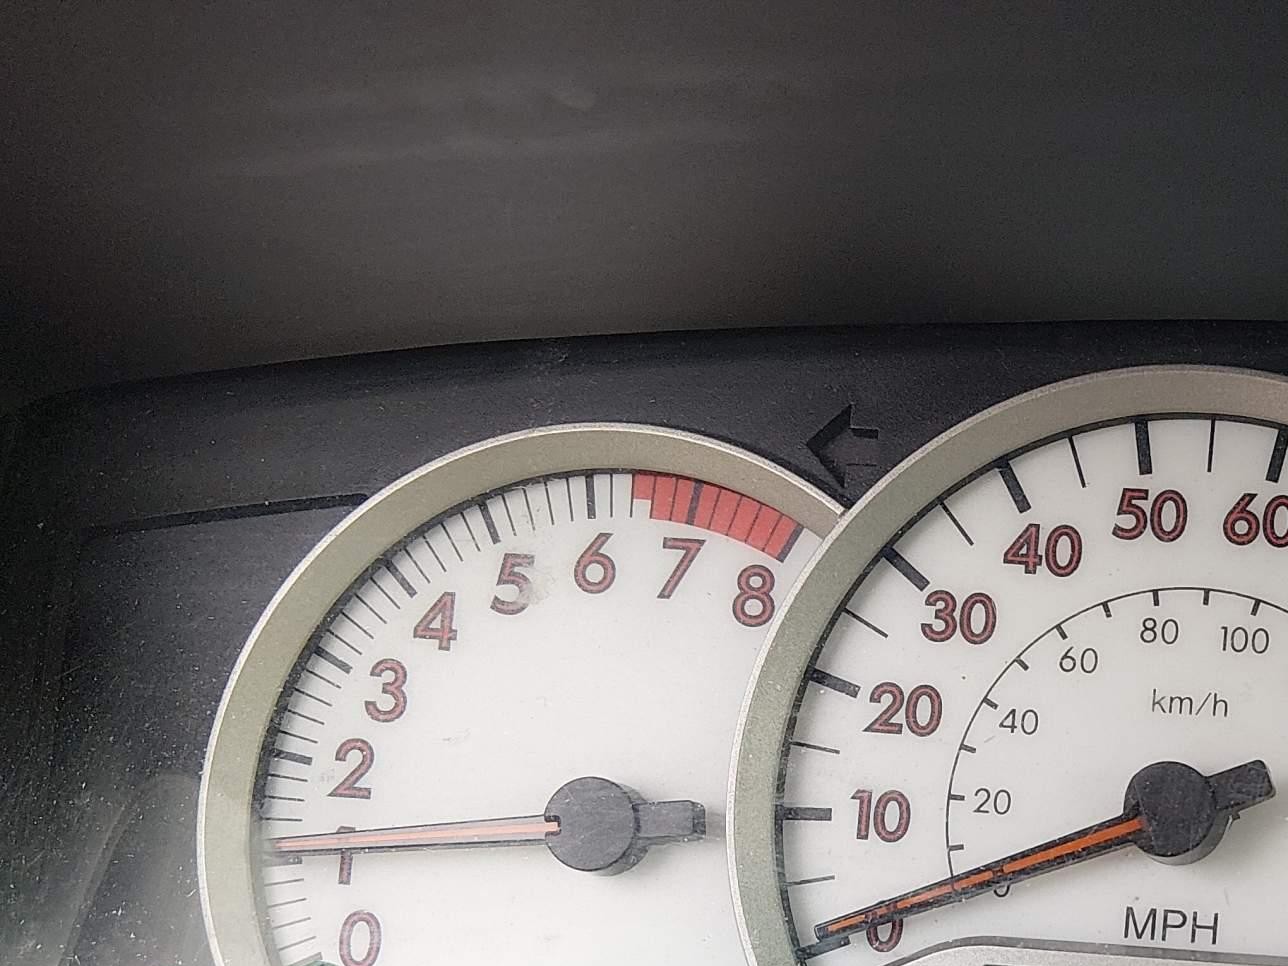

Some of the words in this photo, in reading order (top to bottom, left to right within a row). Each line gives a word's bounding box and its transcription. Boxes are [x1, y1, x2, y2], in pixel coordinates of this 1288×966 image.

[1112, 487, 1188, 543] 50
[574, 532, 616, 594] 6
[657, 537, 706, 599] 7
[1003, 523, 1083, 577] 40
[490, 553, 535, 615] 5
[733, 564, 775, 627] 8
[413, 591, 457, 651] 4
[920, 590, 997, 645] 30
[1139, 617, 1179, 645] 80
[1220, 626, 1270, 654] 100
[1058, 647, 1098, 675] 60
[364, 658, 407, 722] 3
[862, 681, 943, 737] 20
[1152, 689, 1229, 718] km/h
[999, 708, 1039, 736] 40
[327, 738, 375, 799] 2
[850, 789, 911, 843] 10
[973, 788, 1012, 815] 20
[1123, 906, 1219, 945] MPH
